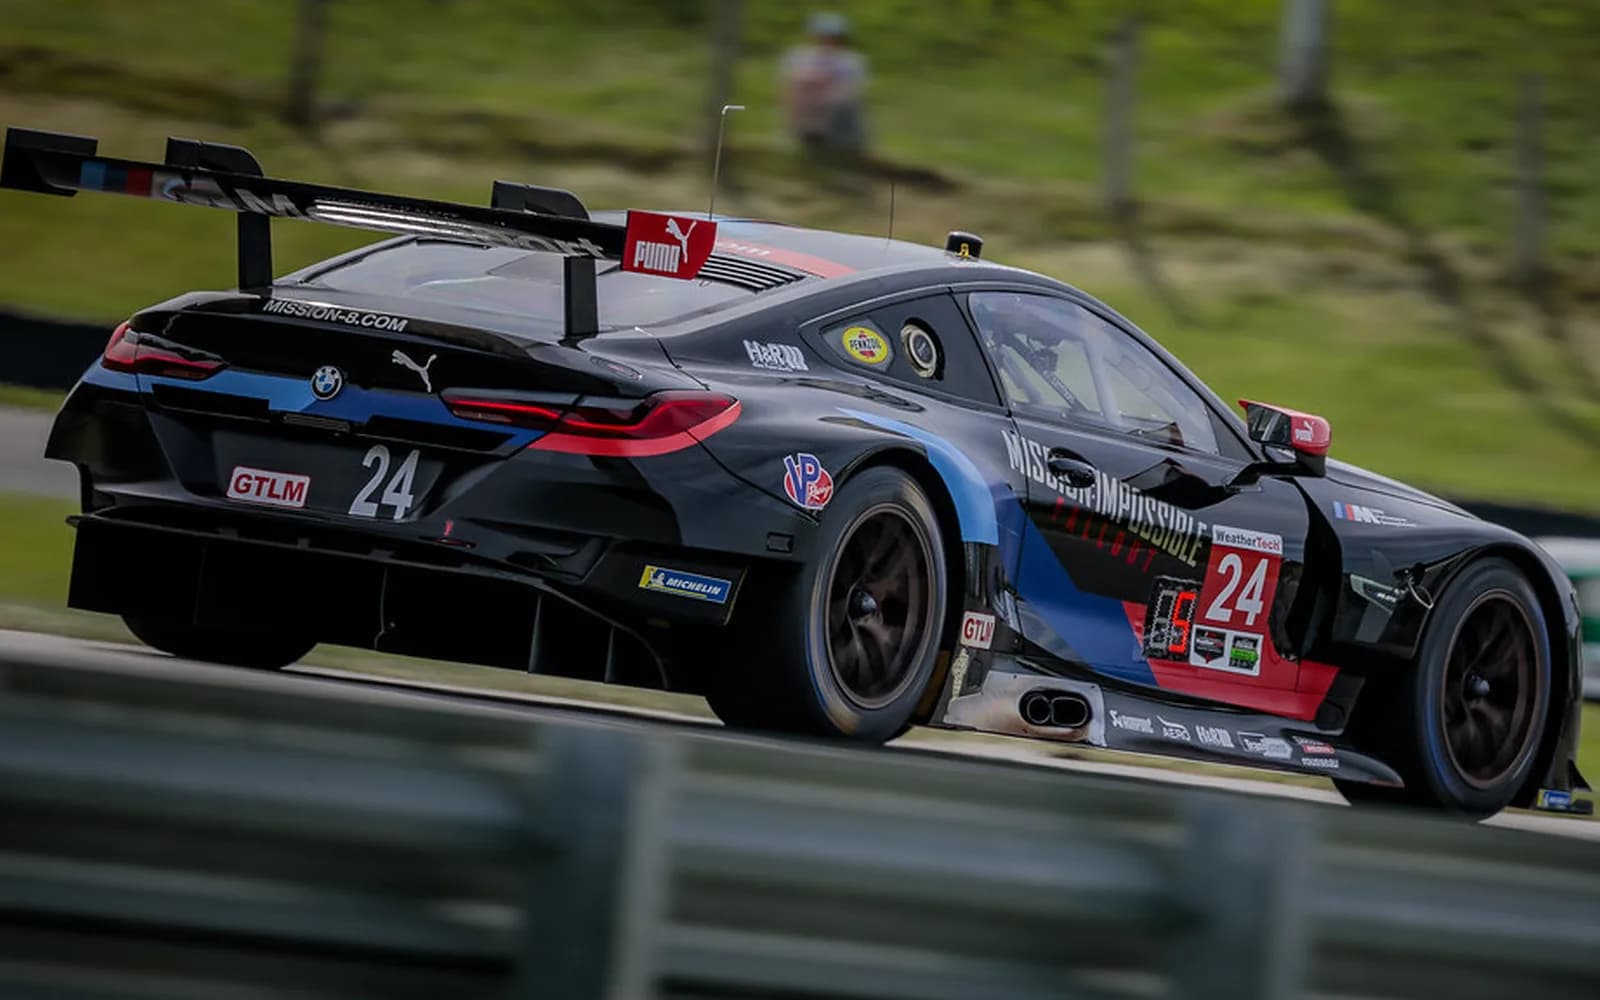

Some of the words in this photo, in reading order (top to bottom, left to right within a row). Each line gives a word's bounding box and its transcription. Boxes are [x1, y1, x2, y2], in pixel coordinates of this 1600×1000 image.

[633, 240, 681, 272] PUMA
[262, 300, 409, 332] MISSION-8.COM
[234, 474, 306, 502] GTLM
[348, 444, 420, 520] 24
[784, 453, 821, 506] VP
[1215, 529, 1280, 551] WeatherTech
[666, 578, 721, 595] MICHELIN
[1205, 553, 1268, 625] 24
